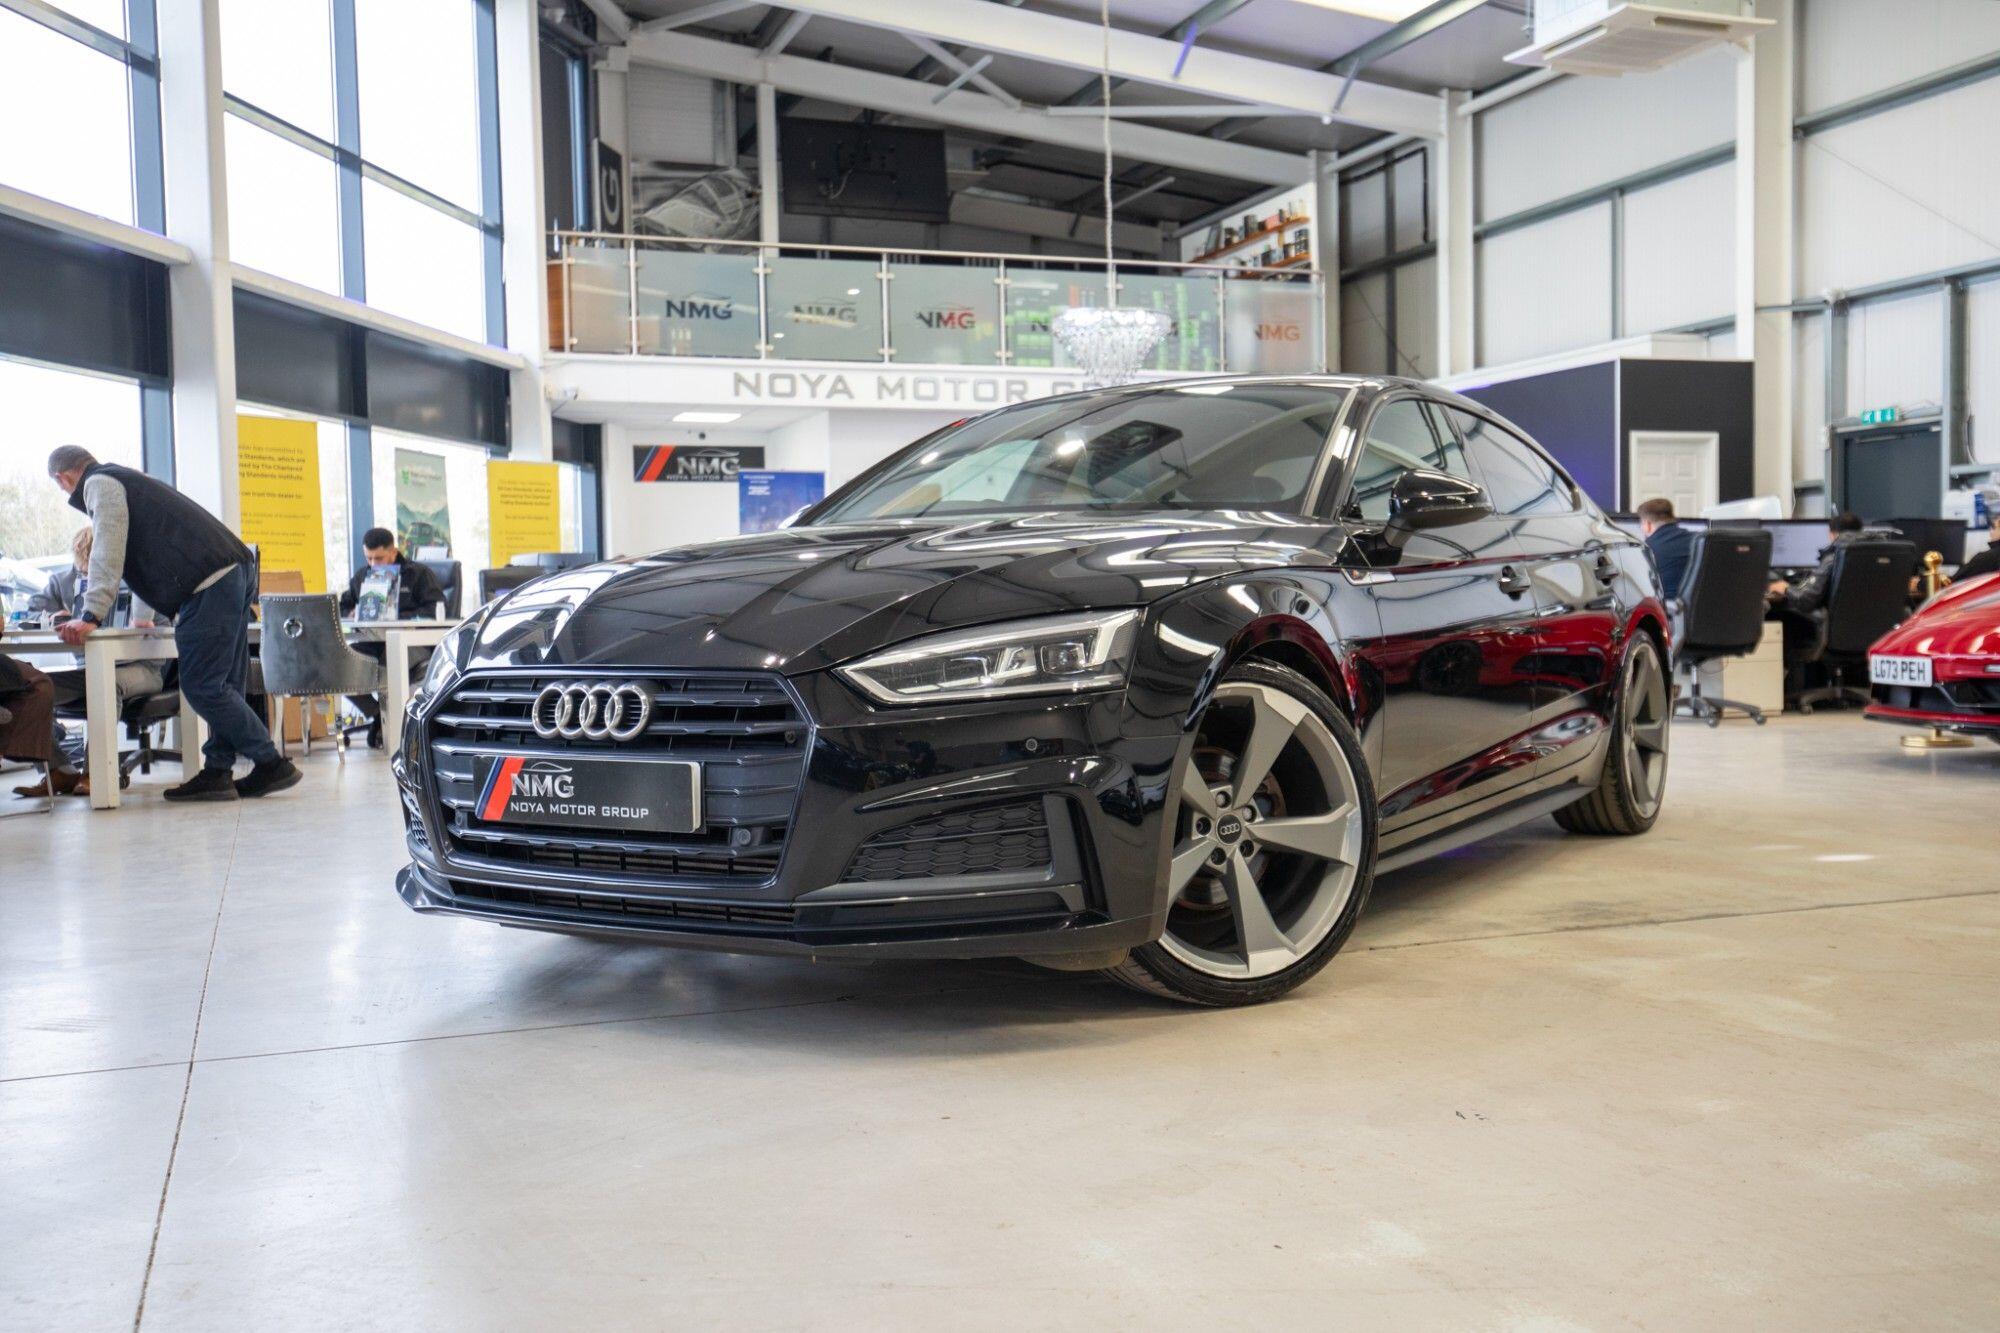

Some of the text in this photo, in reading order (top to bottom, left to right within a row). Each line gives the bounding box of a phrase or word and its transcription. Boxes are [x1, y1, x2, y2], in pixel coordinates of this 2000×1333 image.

[666, 299, 732, 320] NMG
[915, 311, 976, 330] NMG
[733, 372, 855, 399] NOYA
[877, 375, 1028, 402] MOTOR
[677, 457, 740, 475] NMG
[1875, 659, 1925, 682] LG73 PEH
[510, 773, 575, 799] NMG
[510, 802, 650, 819] NOYA MOTOR GROUP
